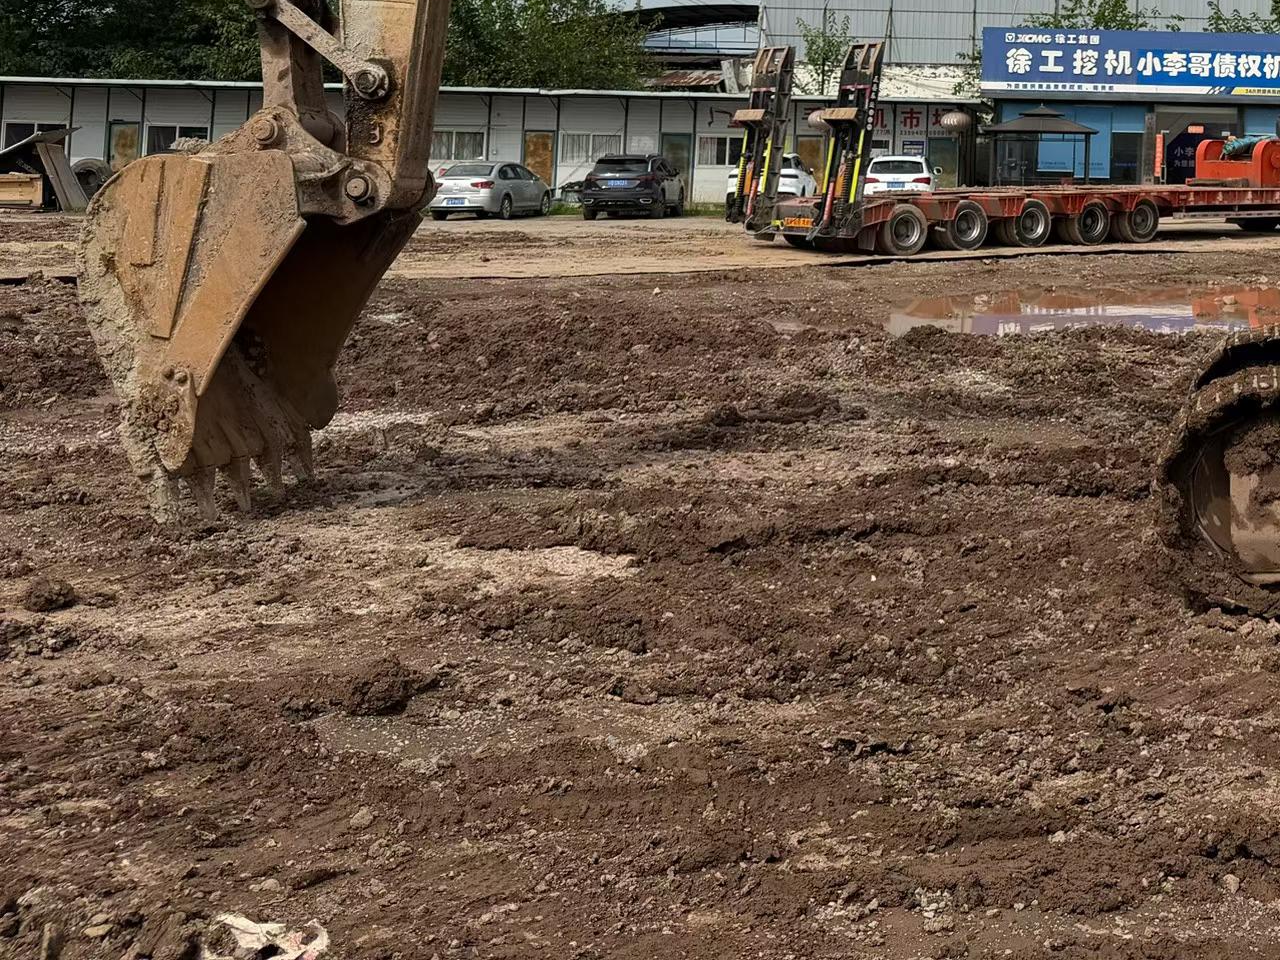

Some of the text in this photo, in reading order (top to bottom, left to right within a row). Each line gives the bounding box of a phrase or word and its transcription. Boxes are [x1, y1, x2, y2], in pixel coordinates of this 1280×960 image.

[1016, 33, 1100, 45] XCMG 徐工集团
